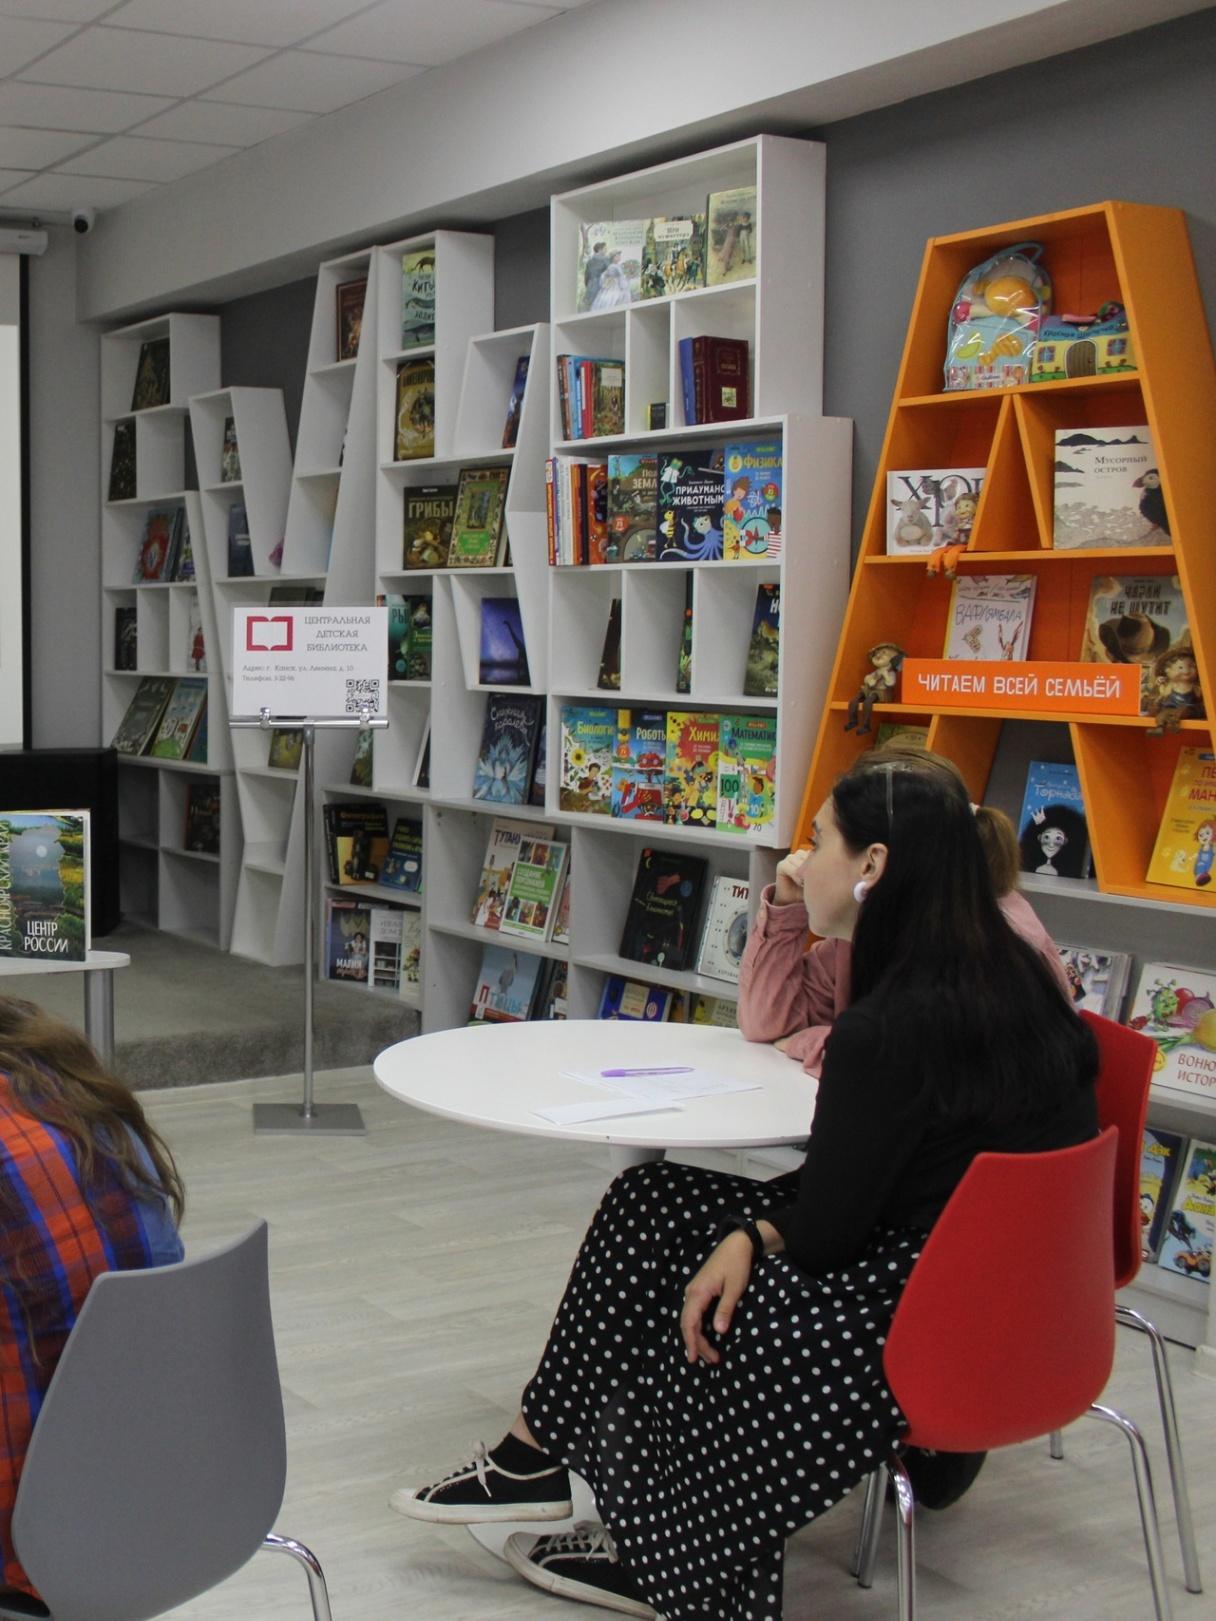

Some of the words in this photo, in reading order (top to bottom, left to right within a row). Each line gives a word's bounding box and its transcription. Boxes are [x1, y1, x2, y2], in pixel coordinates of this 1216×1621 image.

[408, 501, 455, 519] ГРИБЫ
[304, 616, 371, 625] ЦЕНТРАЛЬНАЯ
[316, 630, 359, 638] ДЕТСКАЯ
[306, 643, 368, 652] БИБЛИОТЕКА
[918, 673, 985, 693] ЧИТАЕМ
[993, 673, 1038, 695] ВСЕЙ
[1046, 675, 1120, 698] СЕМЬЁЙ
[27, 920, 58, 936] ЦЕНТР
[24, 936, 69, 953] РОССИИ
